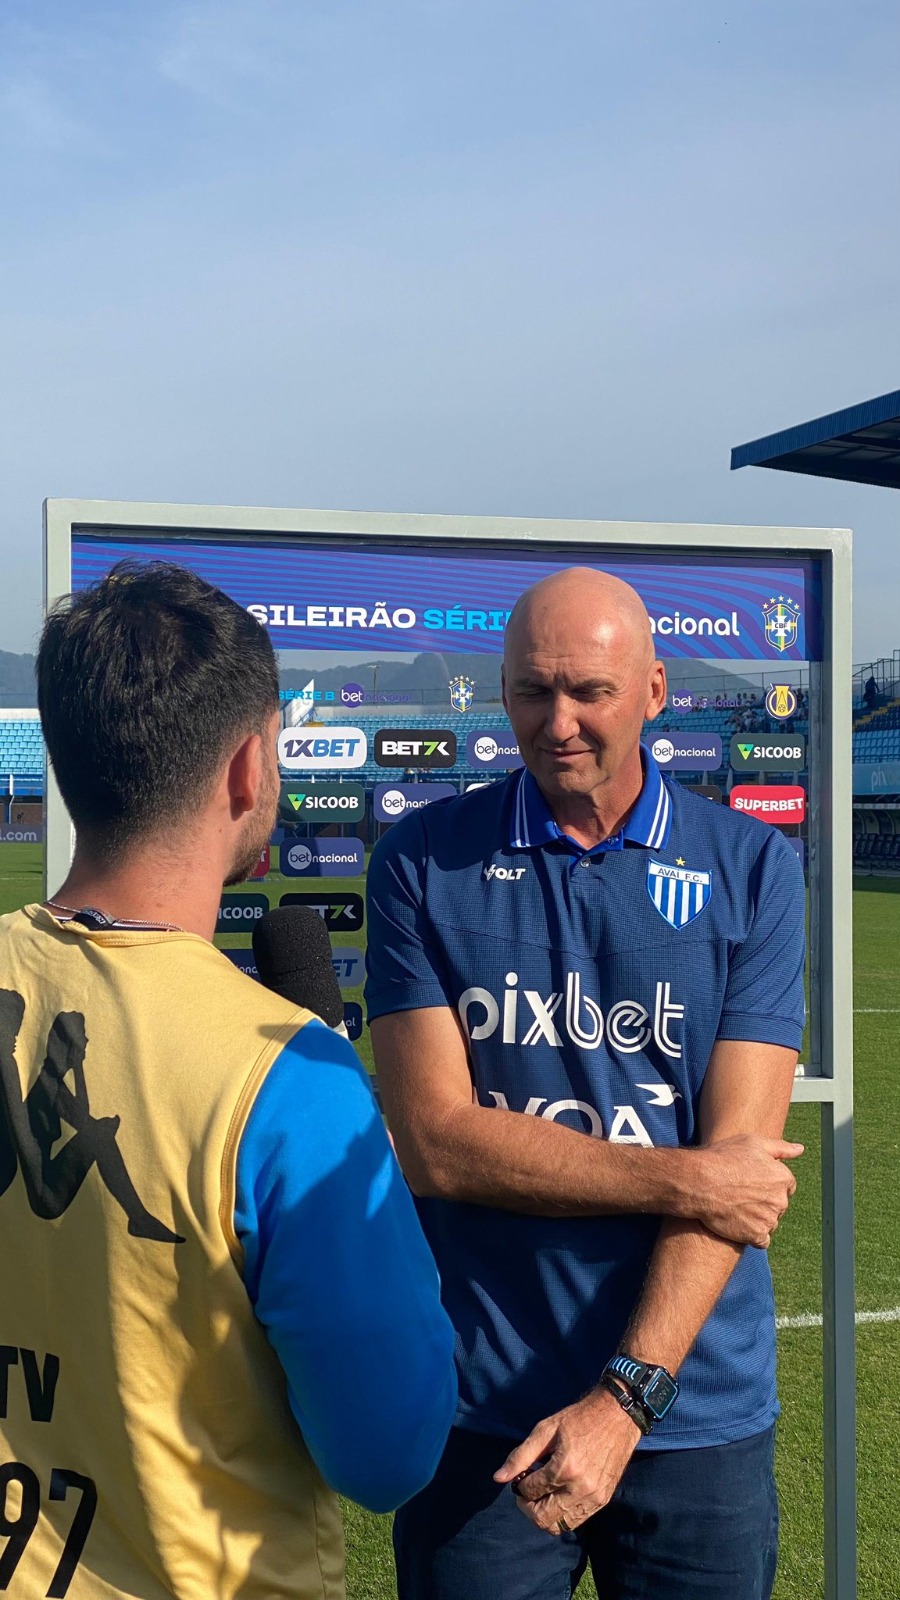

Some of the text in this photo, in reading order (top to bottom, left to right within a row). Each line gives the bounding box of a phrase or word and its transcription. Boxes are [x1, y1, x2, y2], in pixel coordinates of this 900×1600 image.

[423, 604, 510, 631] SÉRI
[278, 688, 335, 701] SÉRIE B
[284, 739, 361, 758] 1XBET
[381, 741, 450, 756] BET7K
[753, 746, 802, 759] SICOOB
[305, 796, 359, 809] SICOOB
[734, 797, 804, 812] SUPERBET
[483, 864, 526, 881] VOLT
[305, 904, 357, 919] T7K
[458, 971, 684, 1058] pixbet
